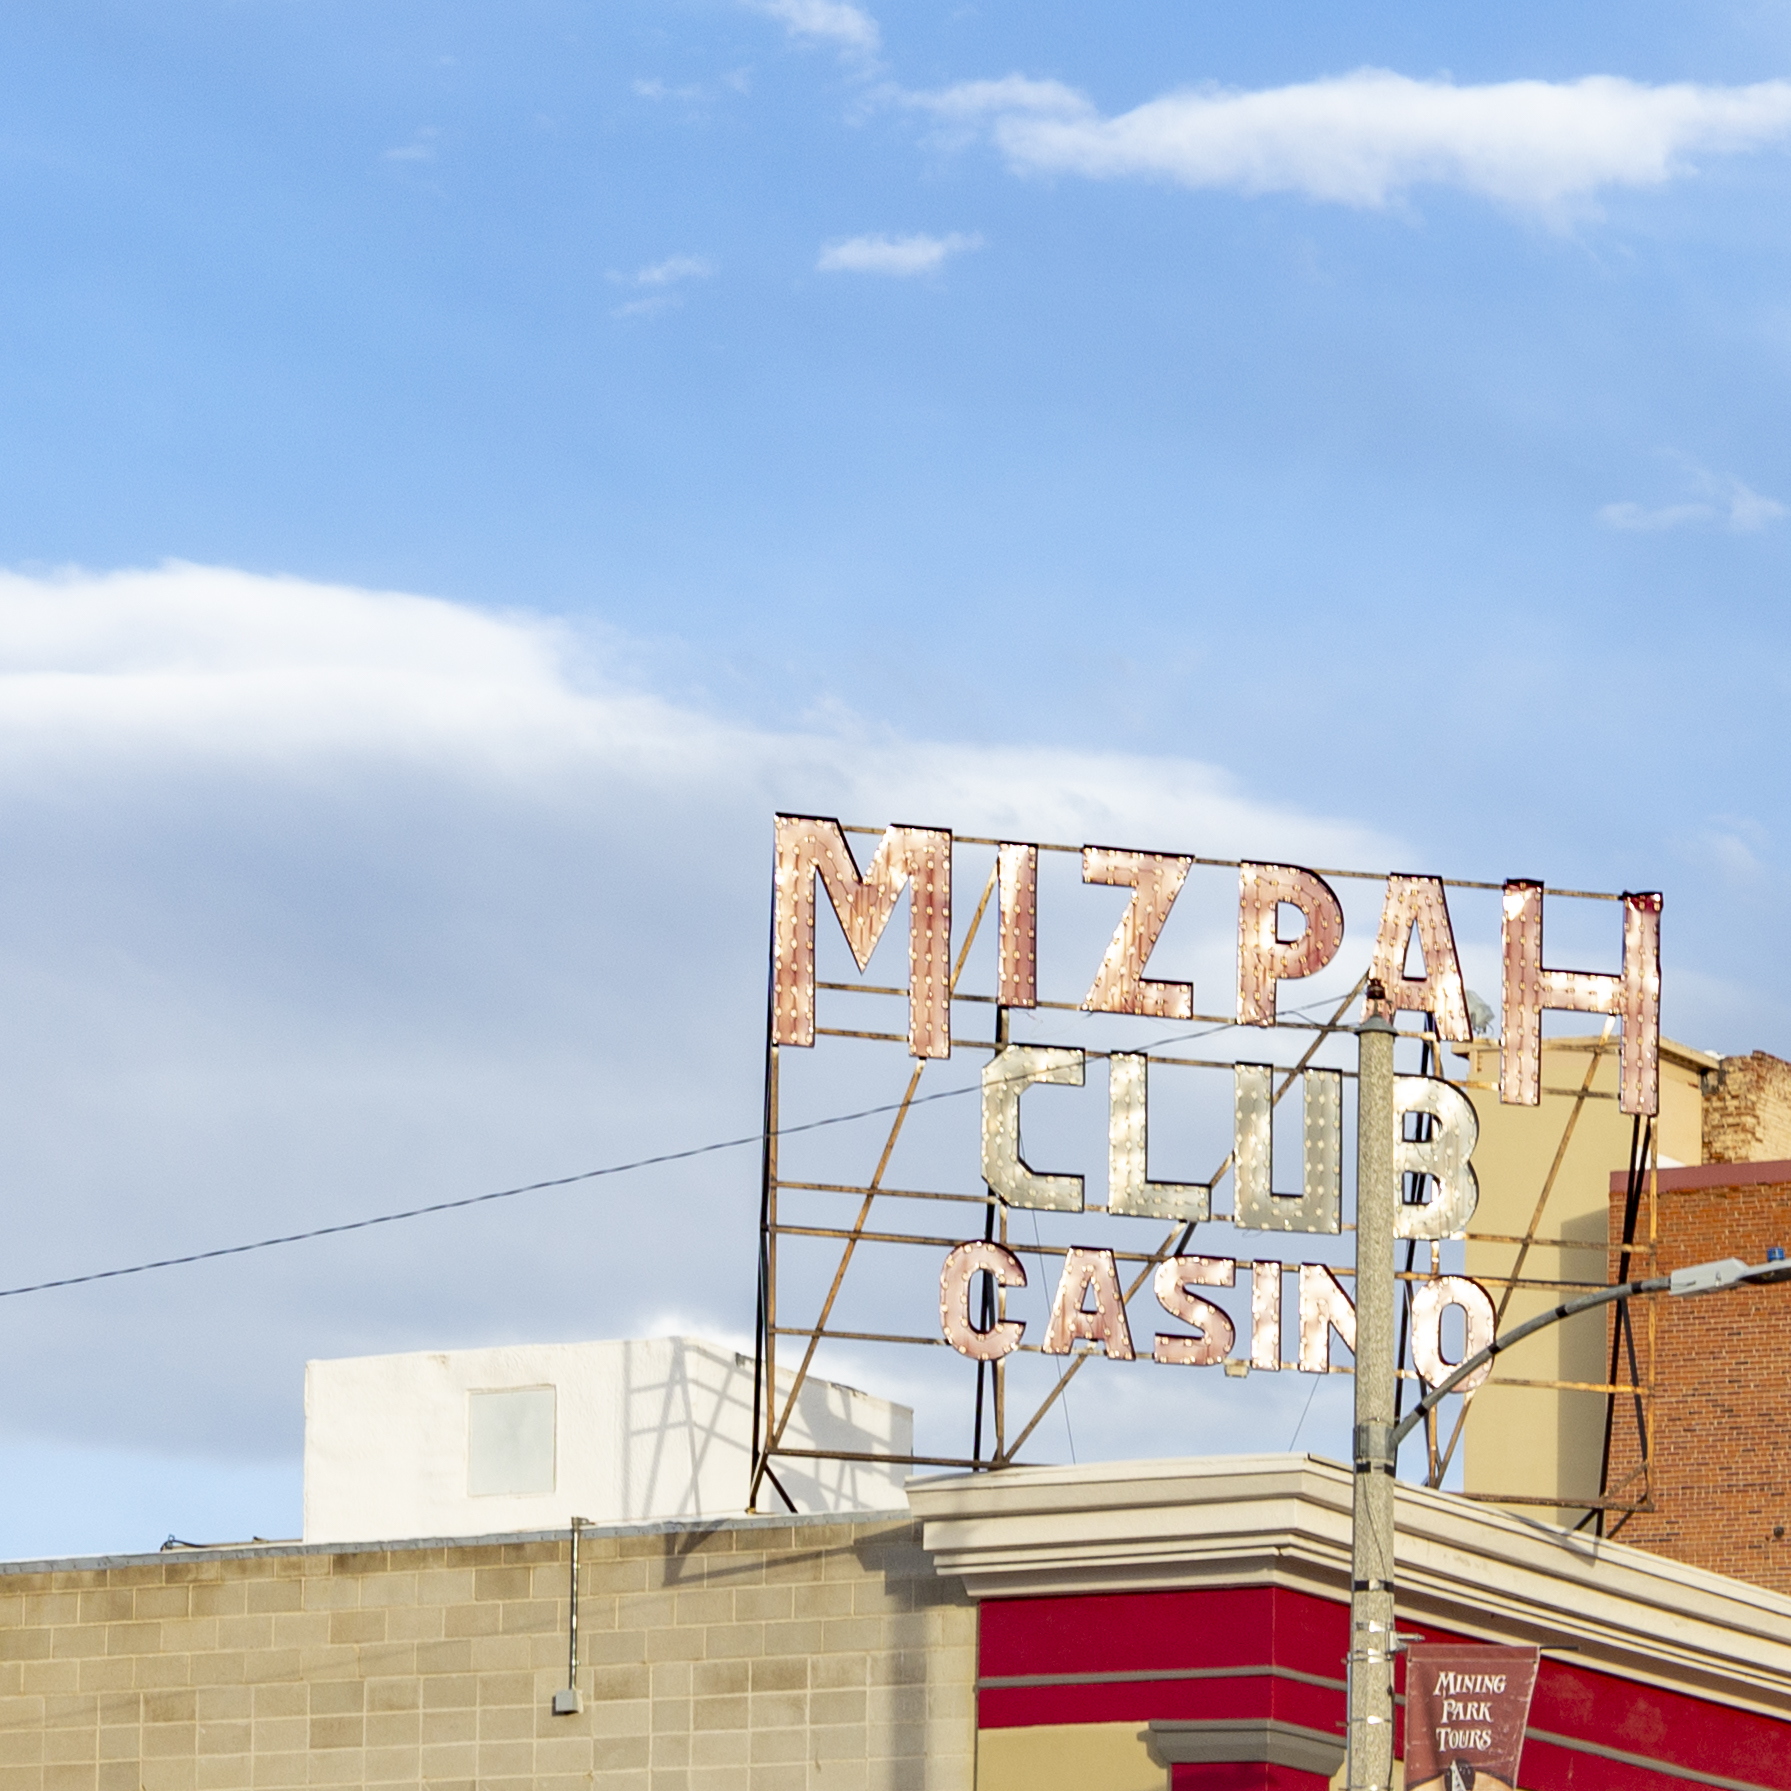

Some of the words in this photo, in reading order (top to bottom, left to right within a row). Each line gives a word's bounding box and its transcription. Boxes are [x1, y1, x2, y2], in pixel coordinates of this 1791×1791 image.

[773, 811, 1664, 1117] MIZPAH
[980, 1043, 1480, 1242] CLUB
[1433, 1670, 1507, 1698] MINING
[1440, 1699, 1494, 1724] PARK
[1435, 1727, 1491, 1752] TOURS
